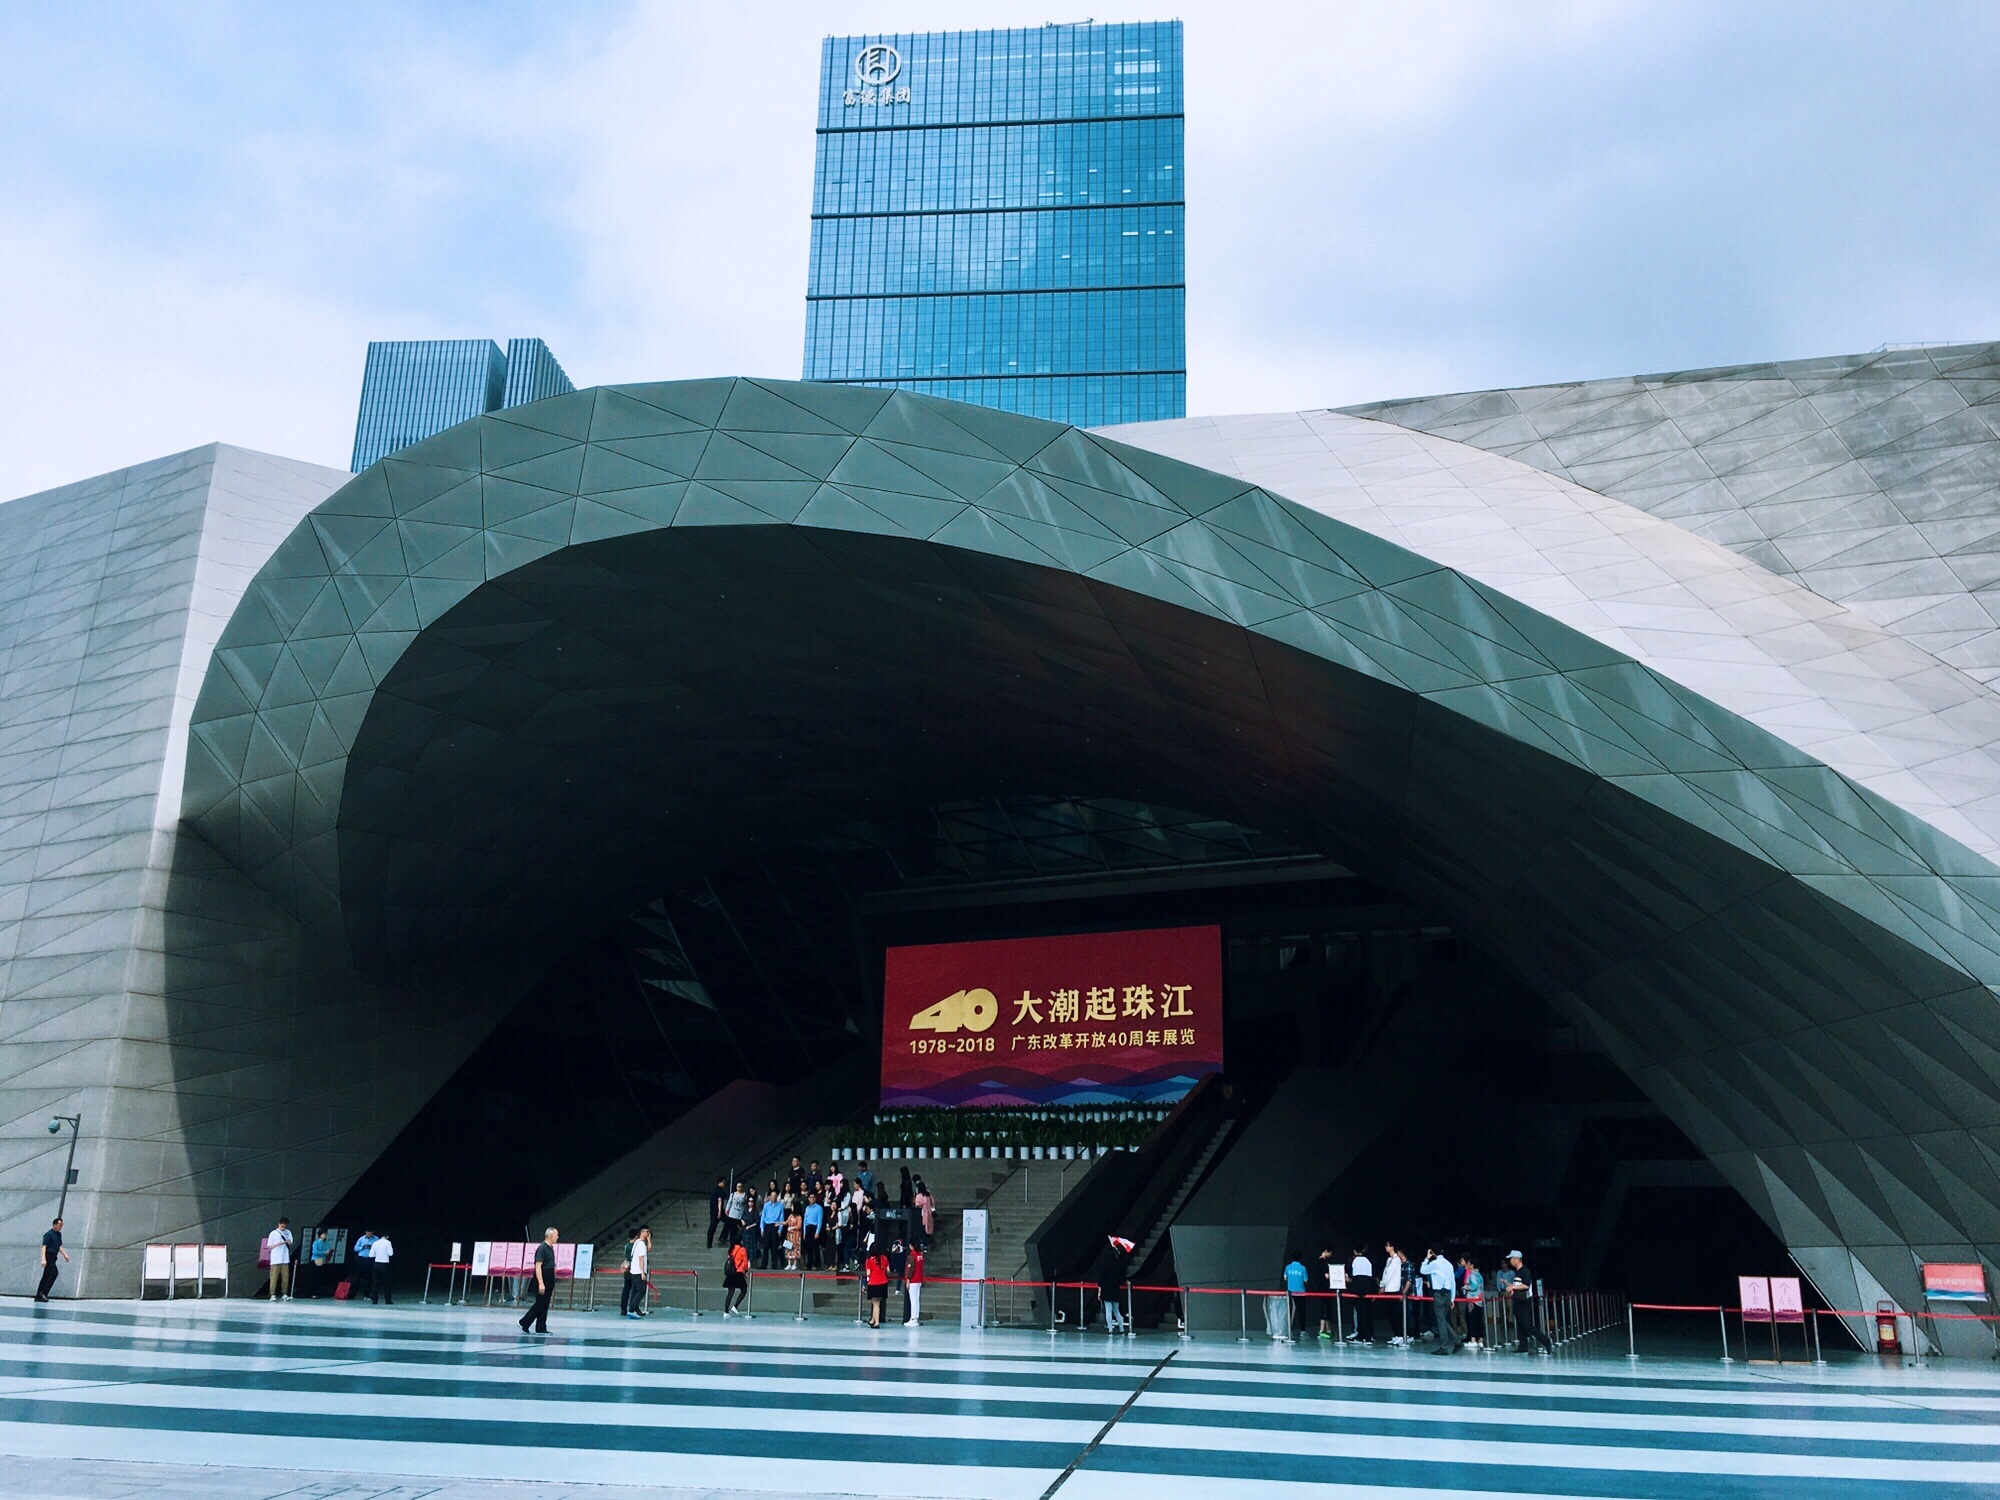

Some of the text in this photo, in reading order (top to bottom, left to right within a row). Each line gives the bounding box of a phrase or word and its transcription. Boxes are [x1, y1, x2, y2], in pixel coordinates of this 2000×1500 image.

[909, 988, 998, 1032] 40
[1011, 984, 1194, 1025] 大潮起珠江
[909, 1037, 995, 1054] 1978~2018
[1011, 1028, 1196, 1051] 广东改革开放40周年展览
